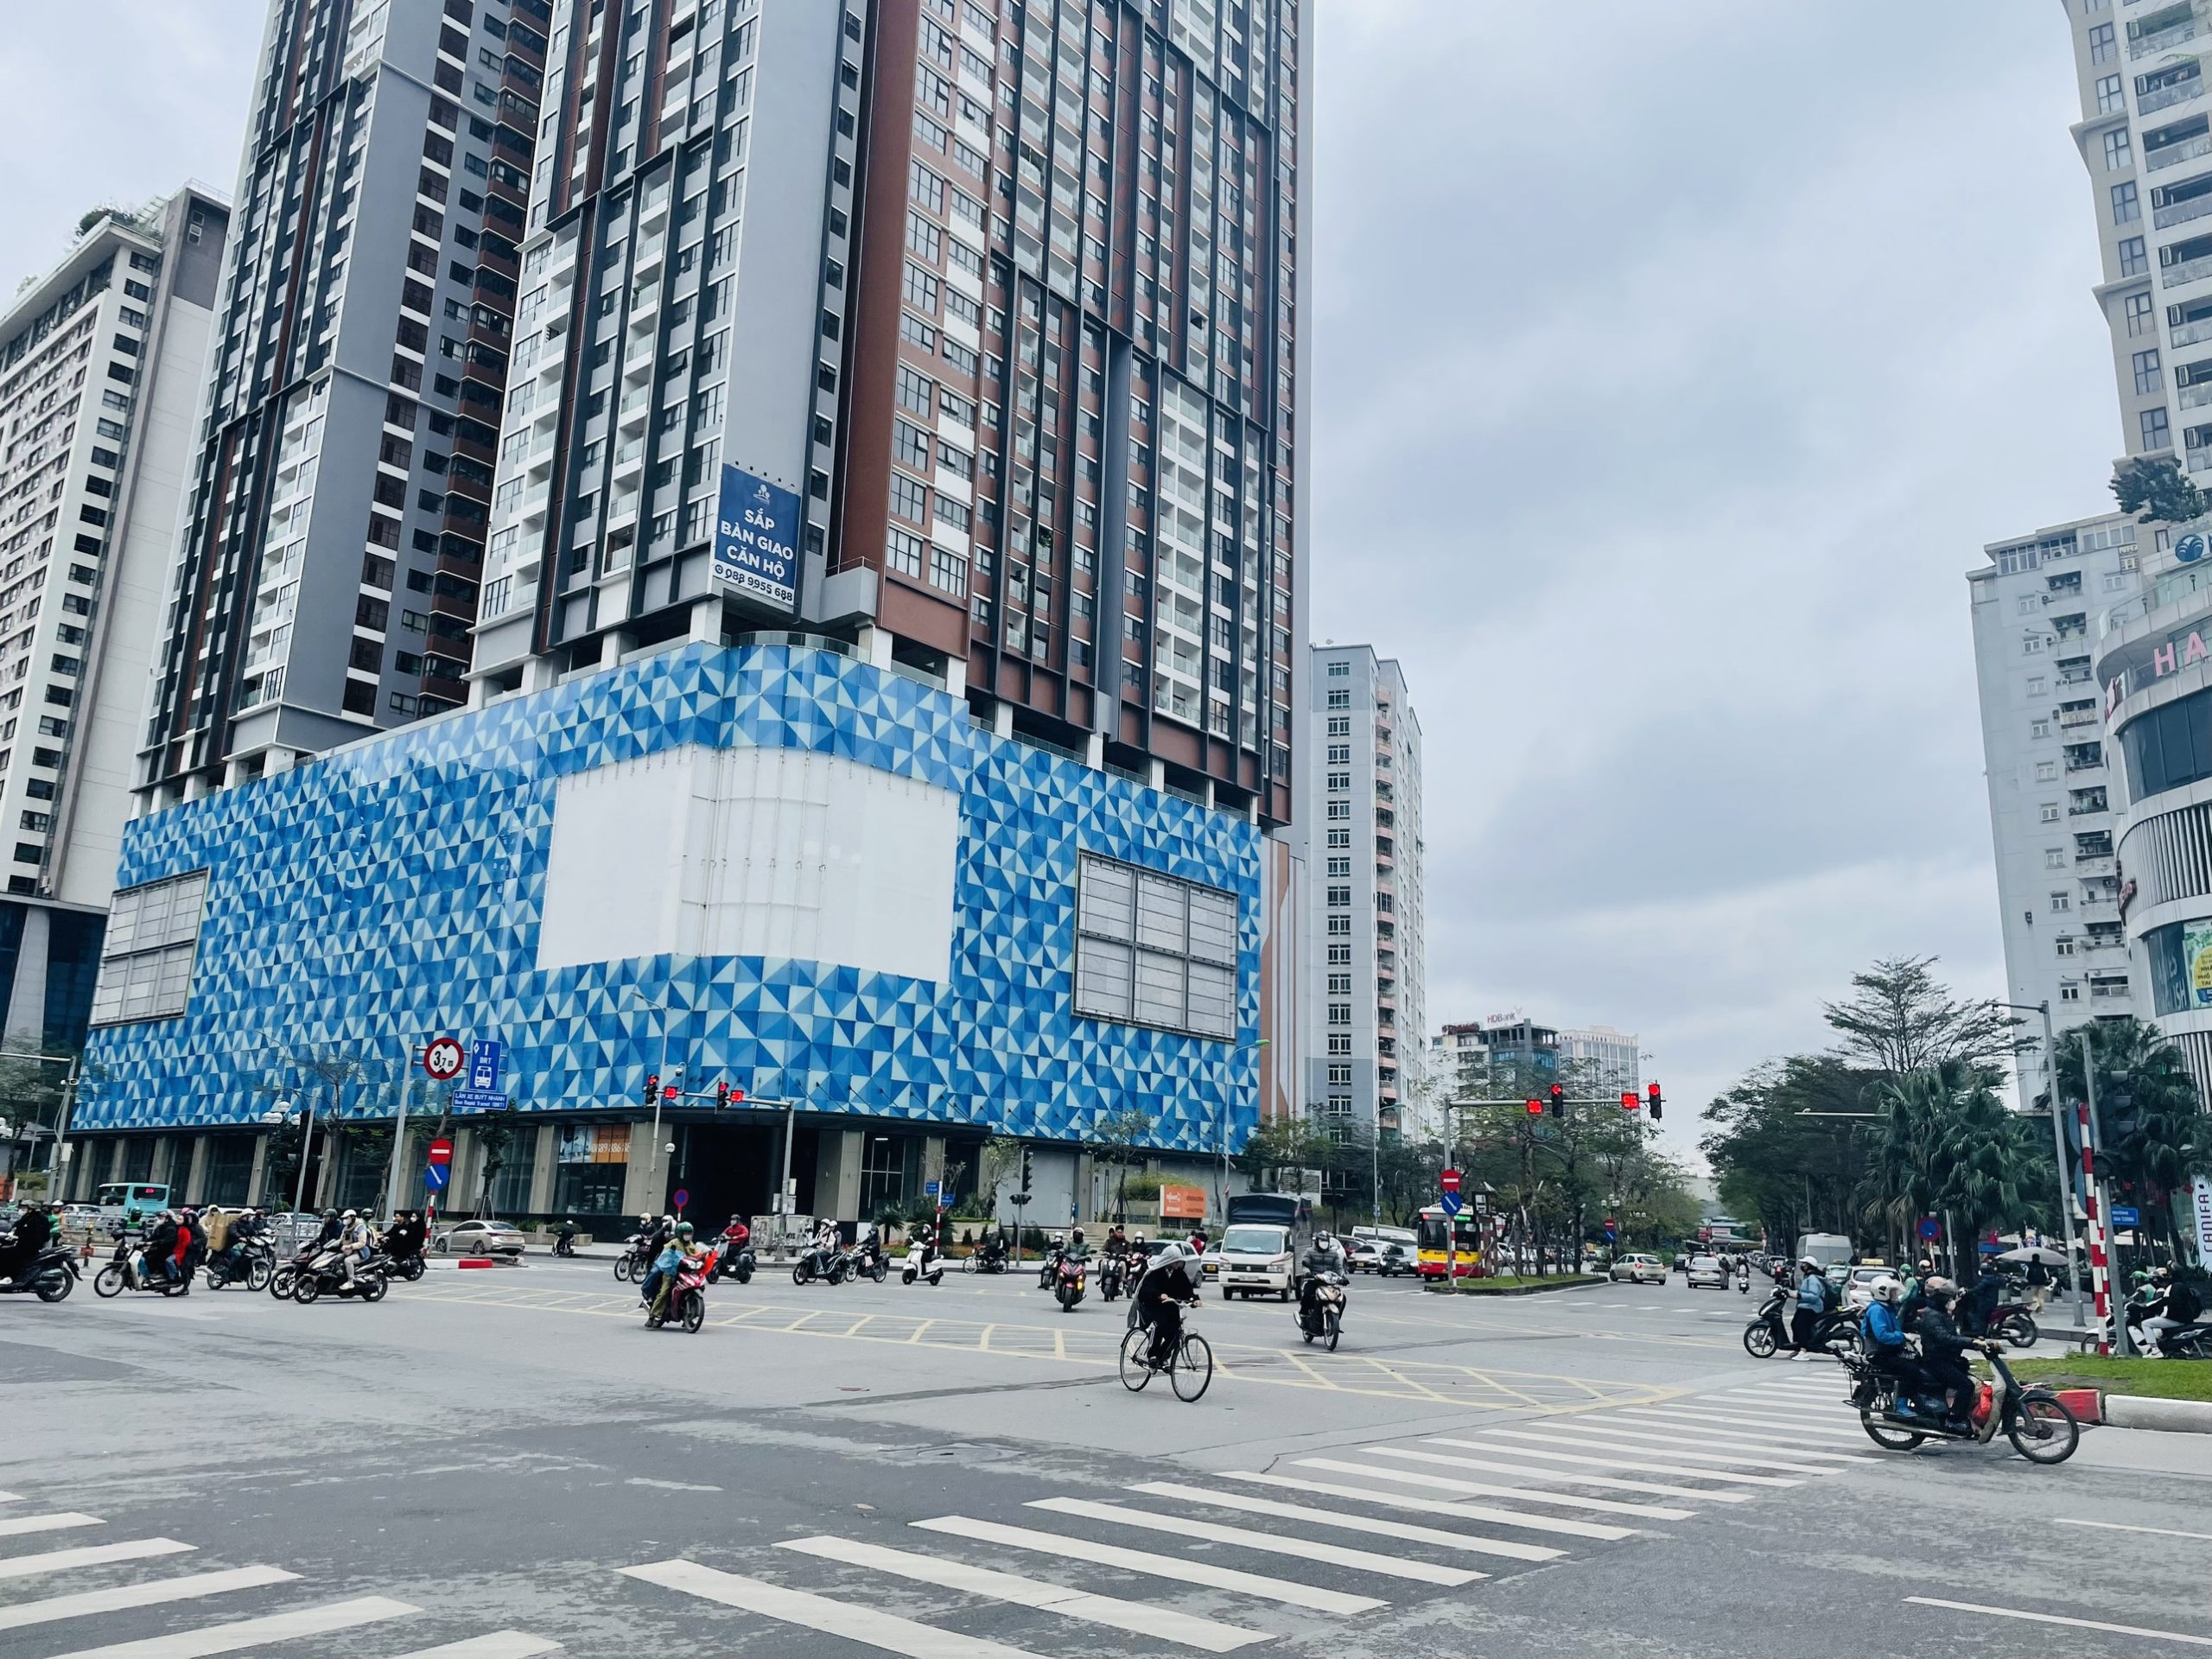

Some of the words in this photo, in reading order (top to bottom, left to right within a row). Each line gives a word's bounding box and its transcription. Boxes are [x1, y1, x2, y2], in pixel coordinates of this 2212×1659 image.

[744, 507, 775, 531] SẮP
[721, 520, 754, 545] BÀN
[757, 536, 794, 561] GIAO
[727, 544, 760, 569] CĂN
[762, 558, 785, 581] HỘ
[747, 576, 772, 594] 9955
[774, 588, 793, 601] 688
[1487, 1012, 1516, 1023] HDBank
[2197, 1194, 2212, 1253] CANIFA
